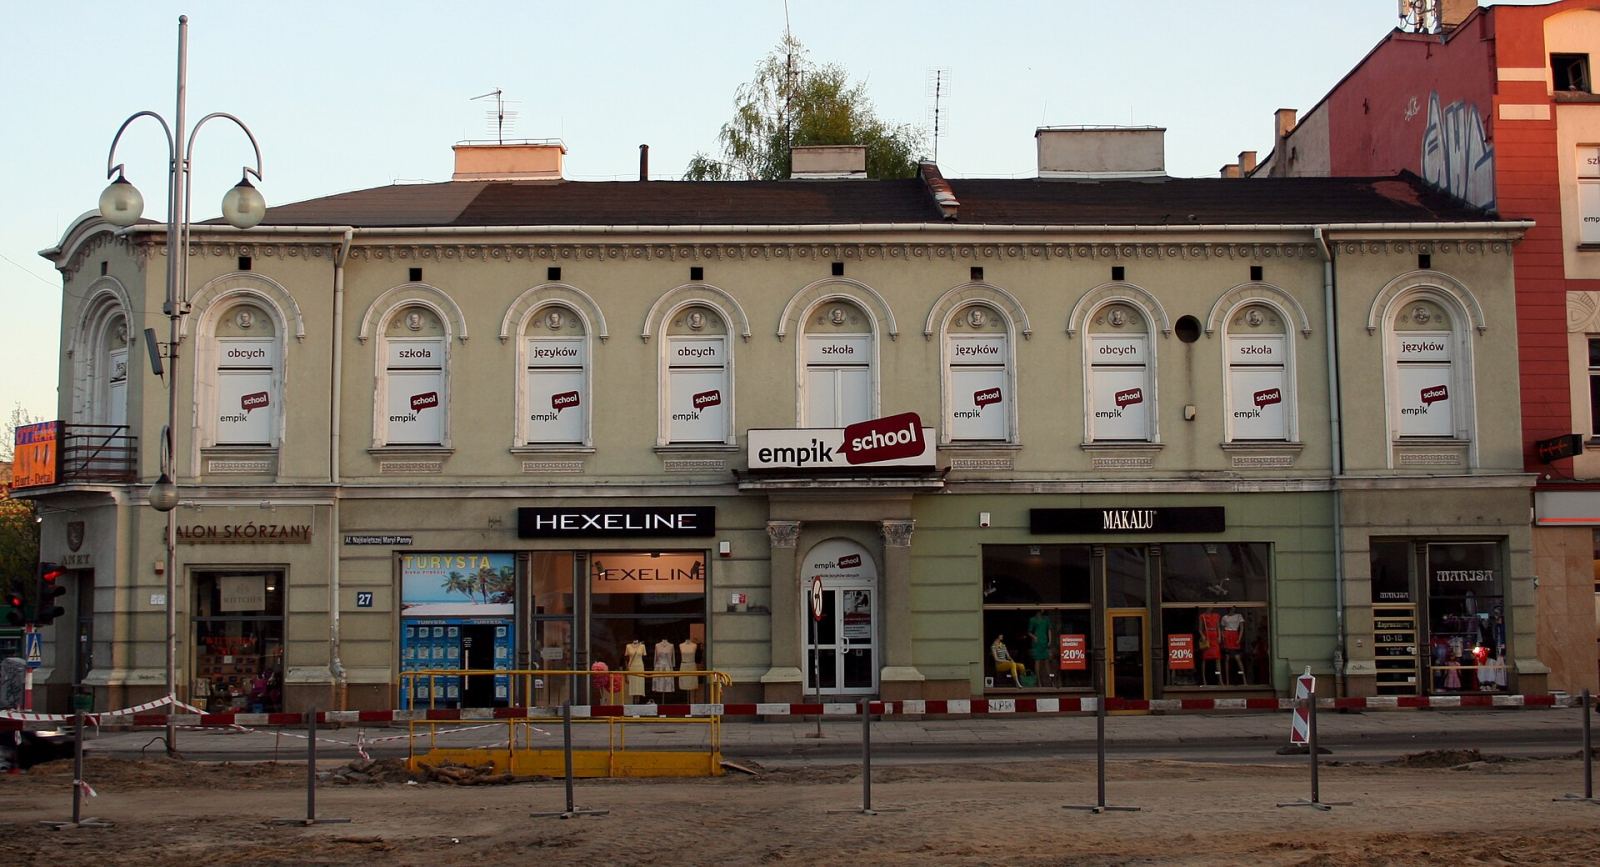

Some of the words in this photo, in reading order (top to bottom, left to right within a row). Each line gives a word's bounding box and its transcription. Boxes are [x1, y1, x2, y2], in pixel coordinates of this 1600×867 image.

[534, 347, 577, 358] języków
[678, 347, 715, 357] obcych
[822, 345, 853, 354] szkoła
[956, 345, 998, 355] języków
[1100, 345, 1136, 356] obcych
[1241, 345, 1271, 354] szkoła
[1402, 342, 1444, 352] języków
[228, 348, 264, 359] obcych
[400, 349, 430, 357] szkoła
[695, 393, 718, 404] school
[976, 390, 1000, 401] school
[1117, 391, 1141, 402] school
[1256, 391, 1279, 402] school
[1423, 388, 1446, 399] school
[243, 394, 267, 405] school
[412, 394, 436, 405] school
[554, 394, 577, 405] school
[953, 408, 981, 420] empik
[1095, 408, 1122, 419] empik
[1234, 408, 1260, 418] empik
[1401, 405, 1428, 415] empik
[220, 412, 247, 423] empik
[389, 412, 417, 423] empik
[531, 411, 558, 422] empik
[672, 411, 699, 422] empik
[758, 438, 833, 466] empik
[852, 423, 916, 451] school
[536, 513, 697, 530] HEXELINE
[1103, 510, 1153, 529] MAKALU
[223, 521, 311, 540] SKÓRZANY
[397, 536, 412, 545] Panny
[403, 556, 491, 569] TURYSTA
[814, 561, 836, 570] empik
[1436, 570, 1494, 582] MARISA
[358, 594, 372, 605] 27
[1061, 650, 1085, 659] -20%
[1169, 650, 1193, 659] -20%
